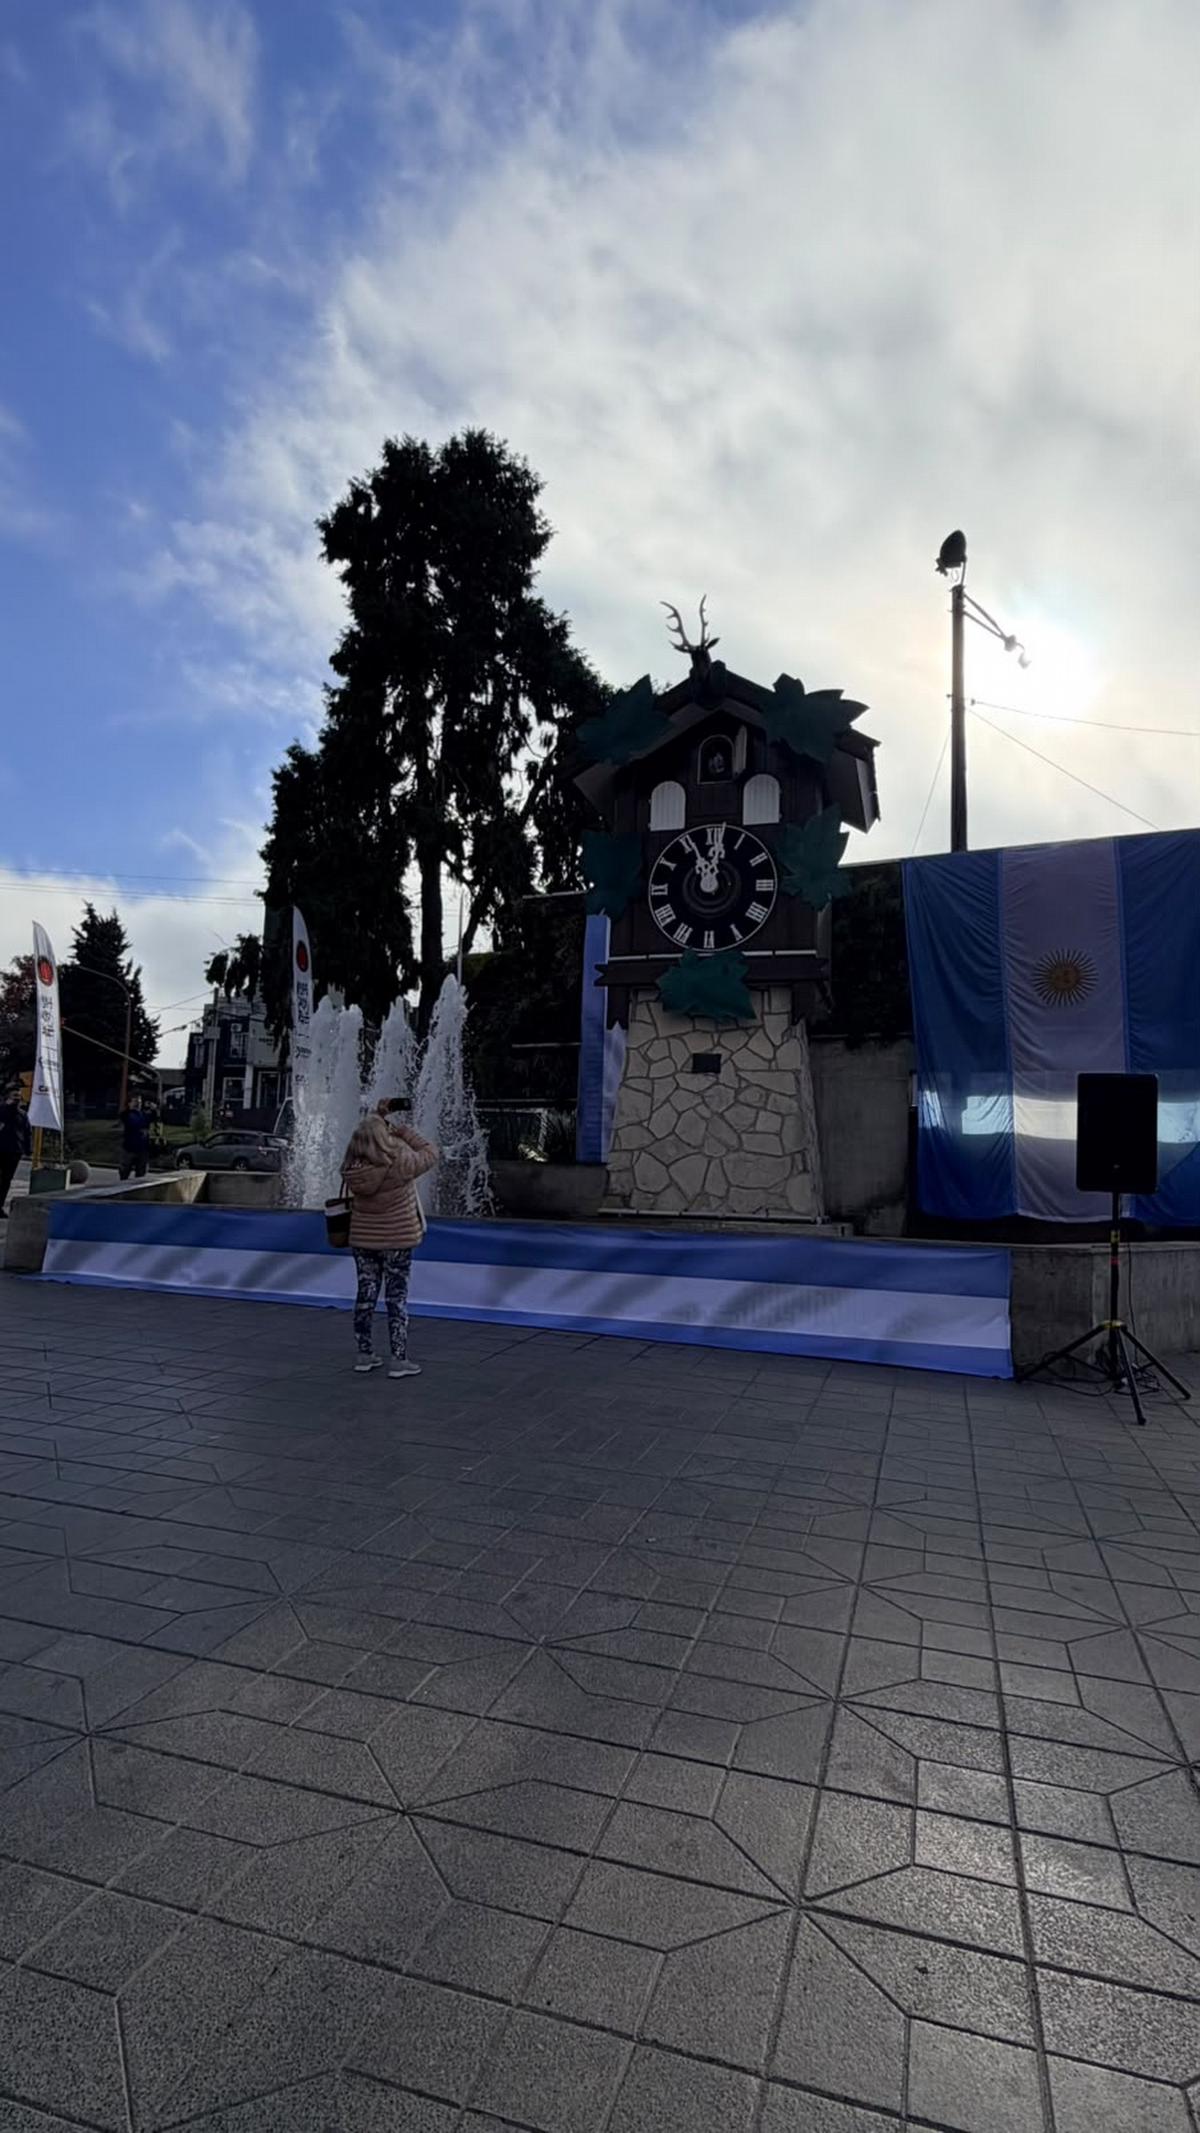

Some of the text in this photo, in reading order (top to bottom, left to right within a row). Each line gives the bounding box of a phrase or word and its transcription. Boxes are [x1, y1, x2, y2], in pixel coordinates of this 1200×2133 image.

[733, 832, 746, 851] I
[748, 851, 768, 868] II
[650, 882, 669, 896] IX
[755, 878, 774, 892] III
[654, 903, 677, 928] VIII
[744, 901, 769, 924] IIII
[672, 922, 694, 944] VII
[703, 929, 715, 949] VI
